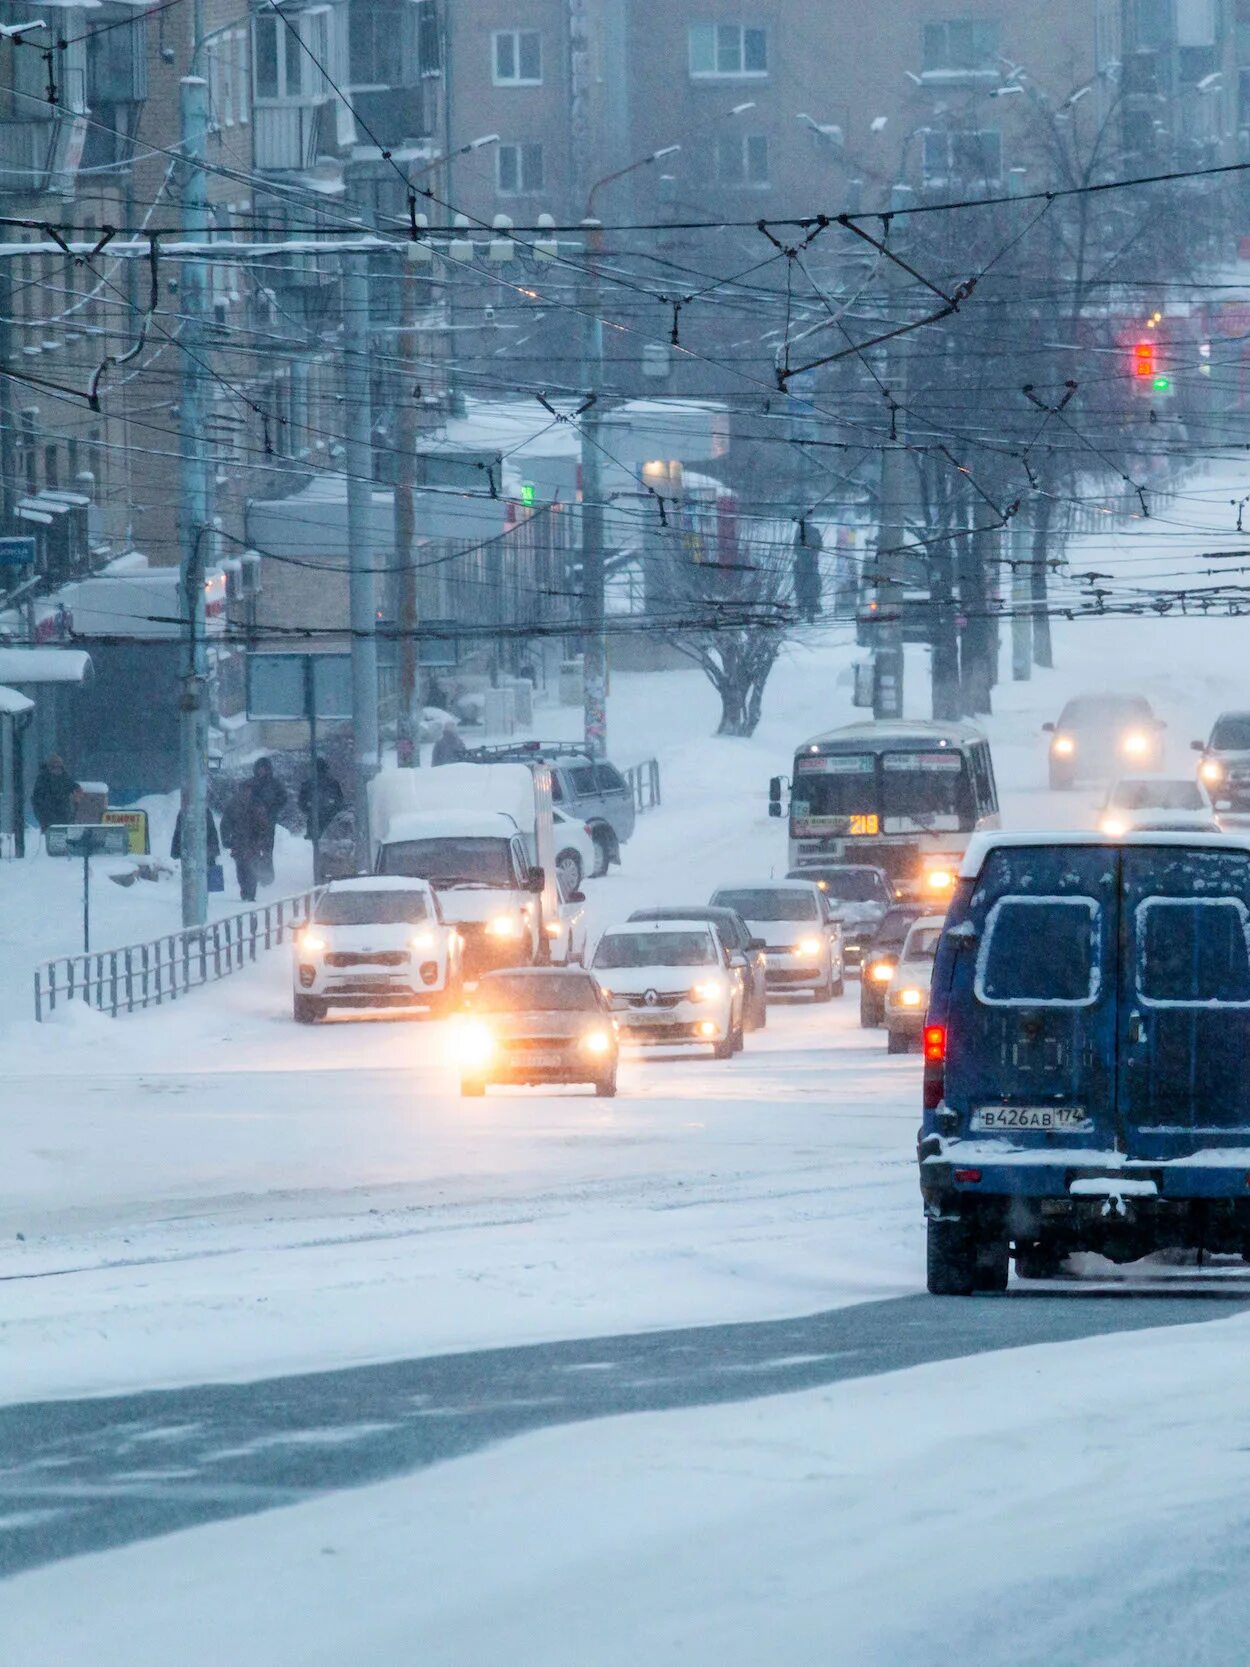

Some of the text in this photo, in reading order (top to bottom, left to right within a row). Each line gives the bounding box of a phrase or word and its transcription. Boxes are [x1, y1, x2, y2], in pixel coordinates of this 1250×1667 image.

[850, 813, 879, 835] 218
[985, 1109, 1083, 1126] В426АВ 174
